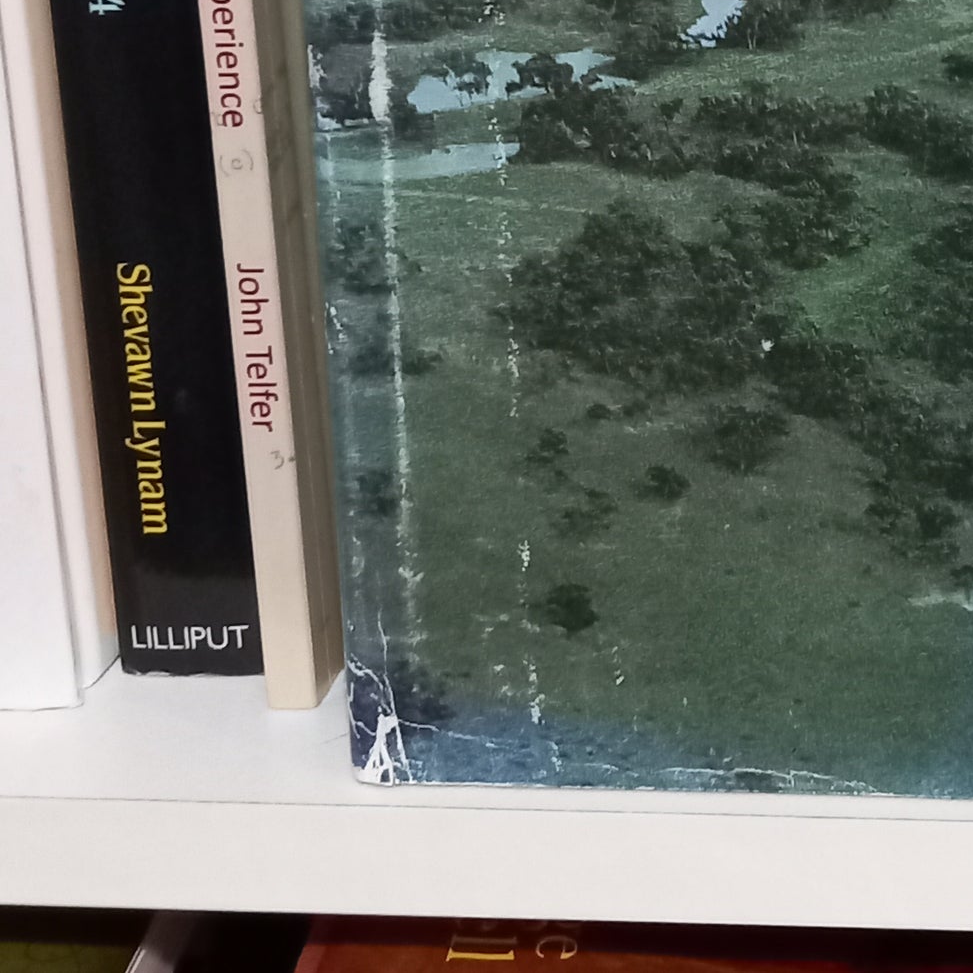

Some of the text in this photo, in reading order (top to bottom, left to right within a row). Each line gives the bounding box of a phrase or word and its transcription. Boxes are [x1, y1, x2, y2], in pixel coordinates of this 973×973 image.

[115, 262, 169, 535] Shevawn Lynam
[236, 262, 280, 433] John Telfer
[130, 623, 250, 652] LILLIPUT
